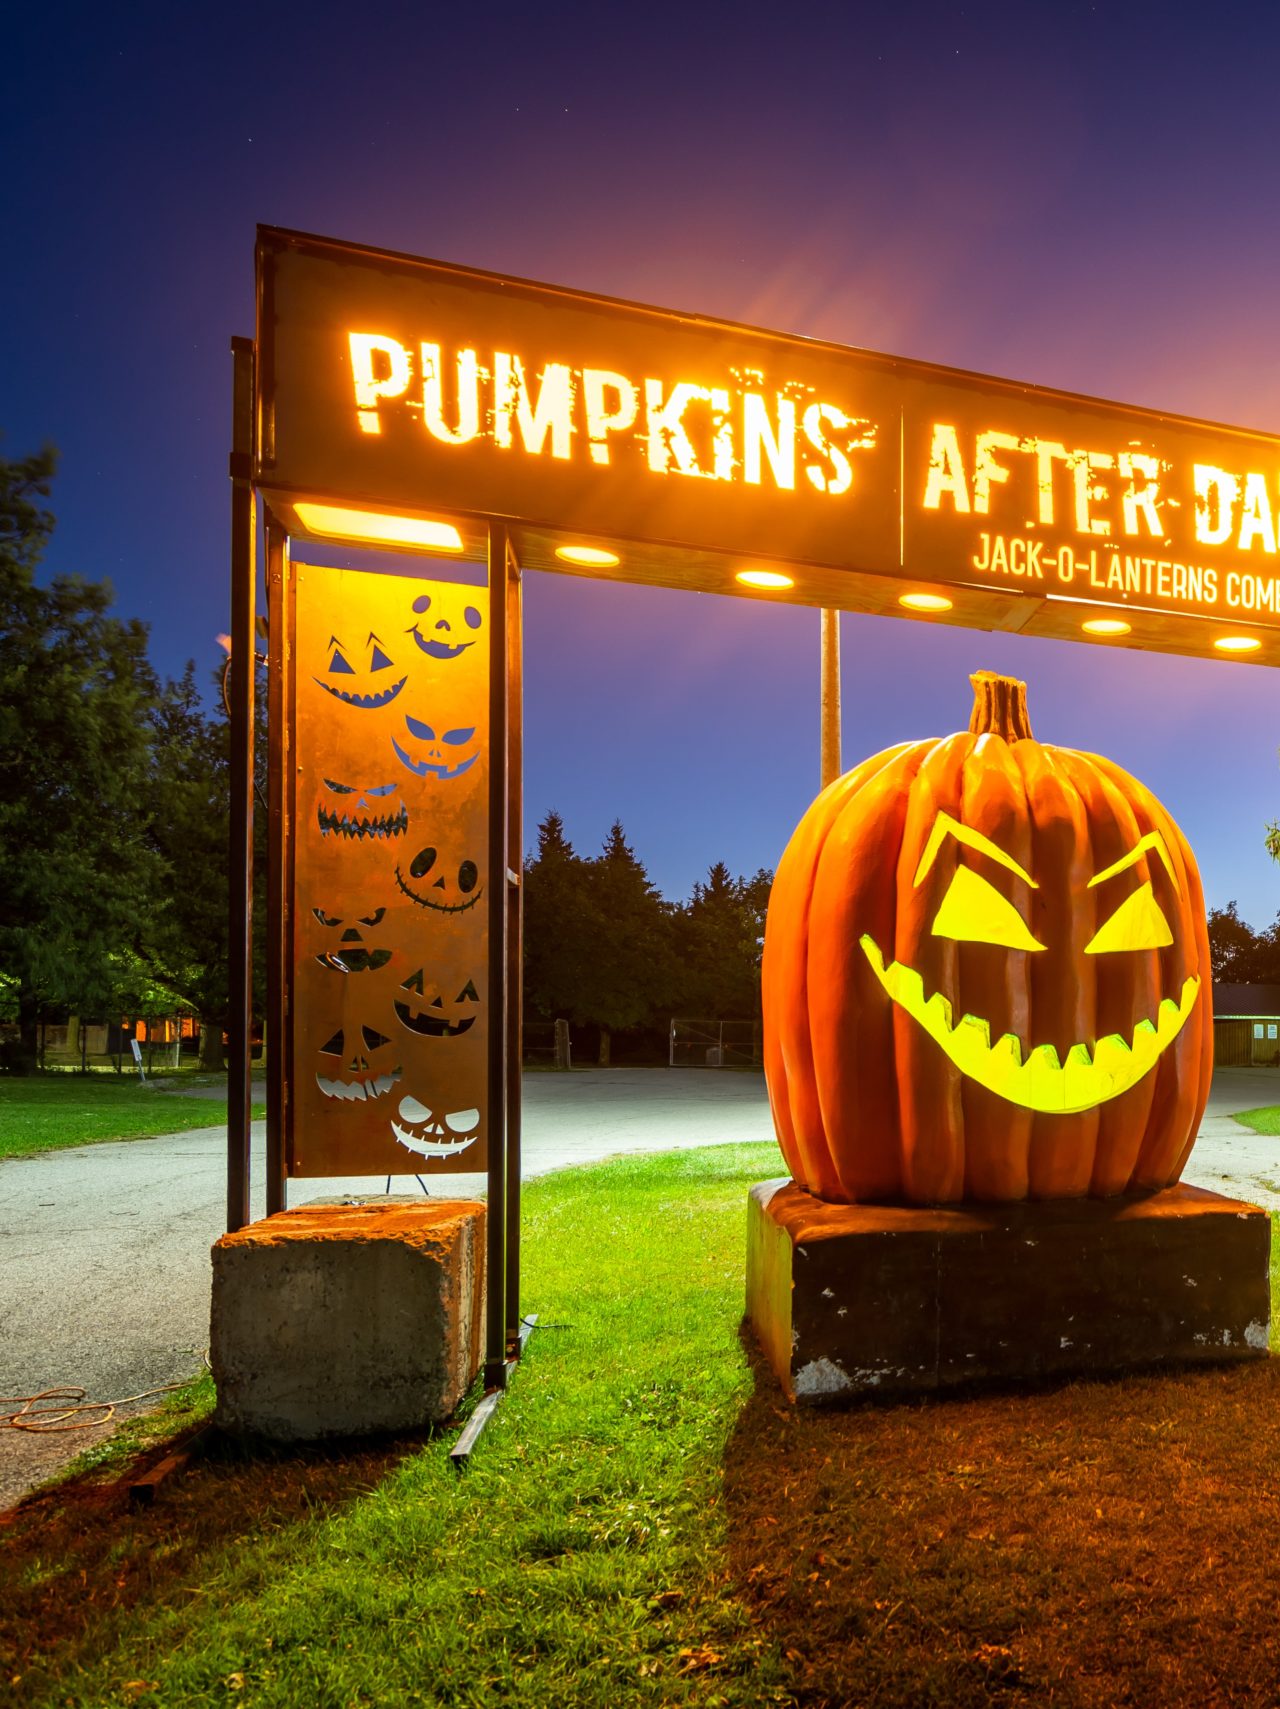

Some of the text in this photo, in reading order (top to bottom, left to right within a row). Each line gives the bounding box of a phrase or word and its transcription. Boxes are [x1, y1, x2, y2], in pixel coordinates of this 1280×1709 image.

[348, 332, 876, 494] PUMPKINS
[923, 424, 1175, 537] AFTER
[972, 533, 1218, 604] JACK-O-LANTERNS
